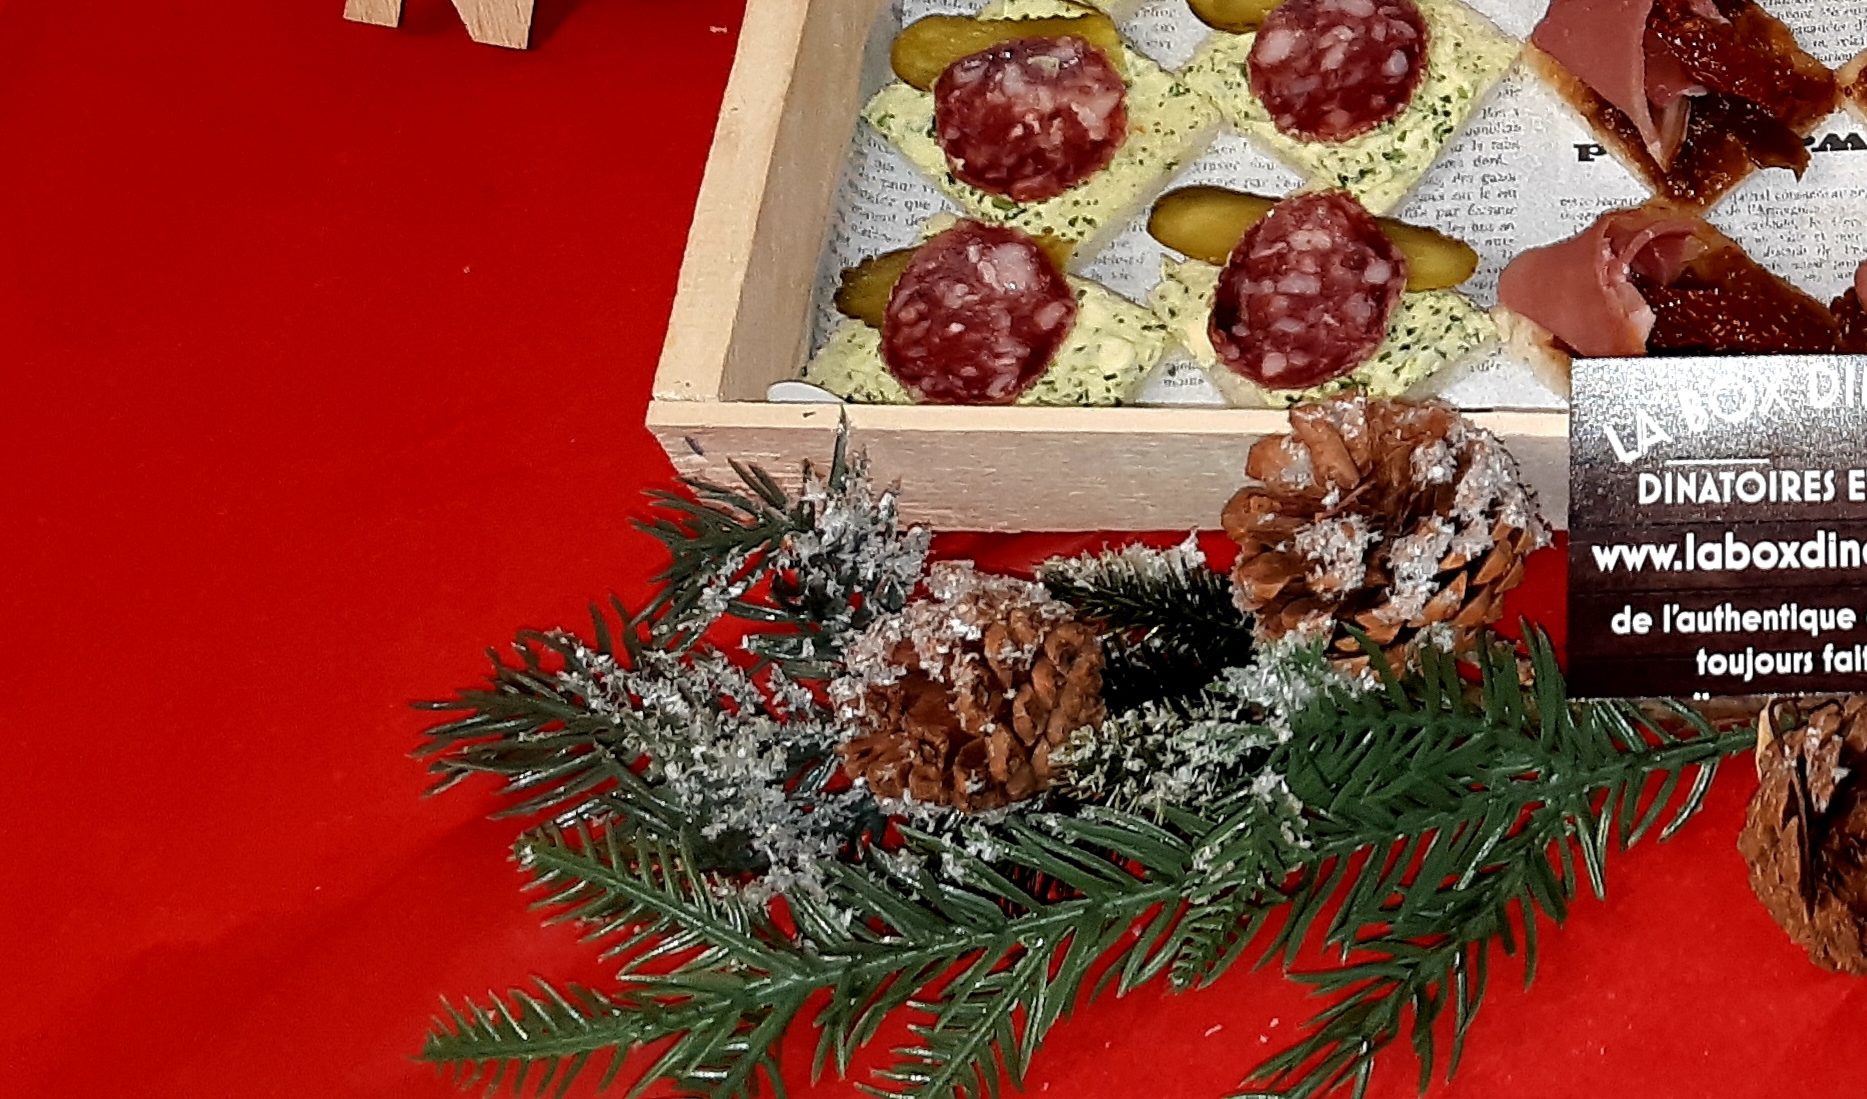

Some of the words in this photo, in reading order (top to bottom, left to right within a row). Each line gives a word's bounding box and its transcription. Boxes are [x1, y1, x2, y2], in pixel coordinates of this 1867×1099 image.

[1604, 408, 1671, 465] LA
[1638, 467, 1836, 506] DINATOIRES
[1611, 603, 1653, 637] de
[1662, 600, 1857, 638] l'authentique
[1695, 646, 1814, 682] toujours
